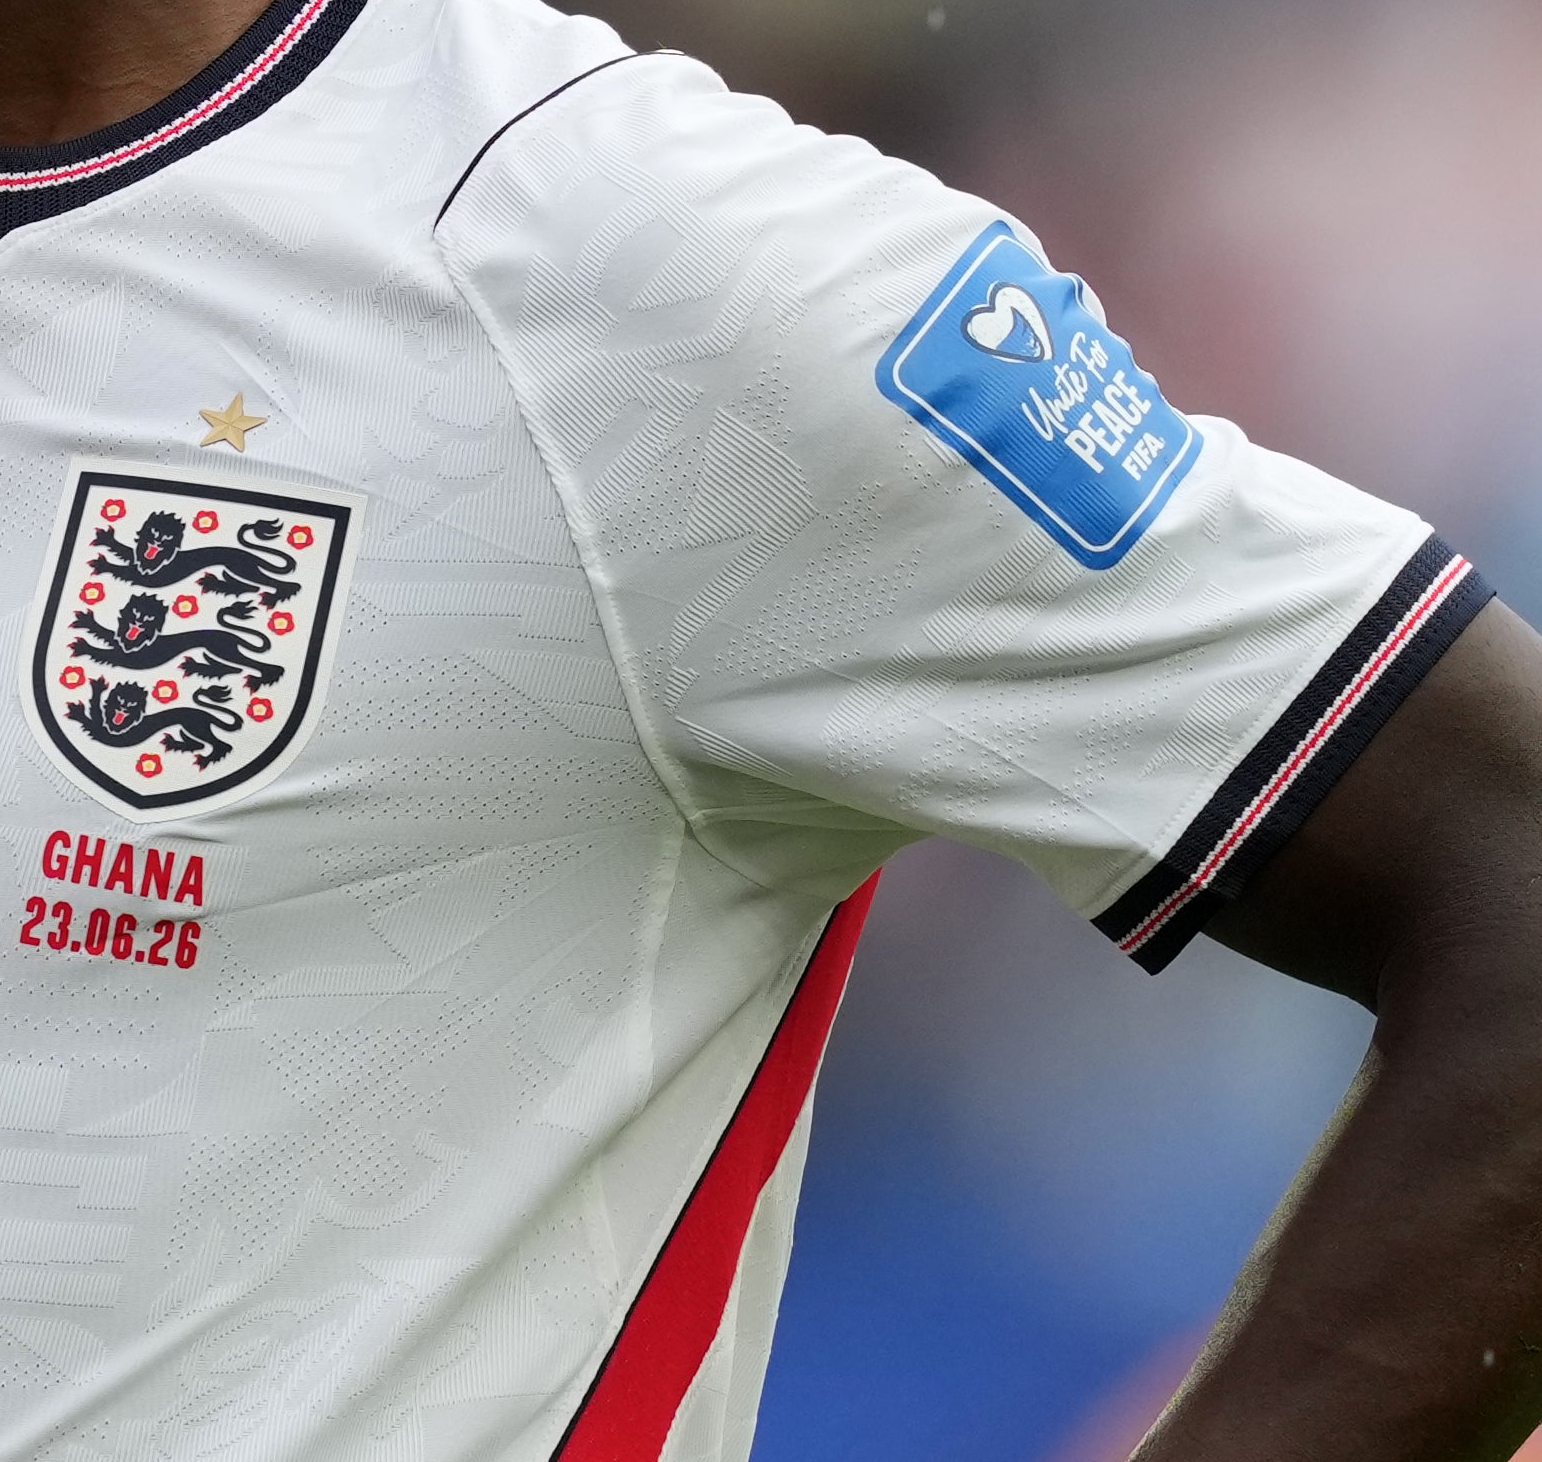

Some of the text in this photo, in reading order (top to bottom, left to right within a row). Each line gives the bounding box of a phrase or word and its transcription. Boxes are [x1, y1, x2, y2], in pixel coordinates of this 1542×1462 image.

[1021, 331, 1109, 441] Unite For
[1064, 370, 1152, 474] PEACE
[1121, 432, 1165, 481] FIFA
[42, 830, 204, 906] GHANA
[20, 896, 201, 969] 23.06.26
